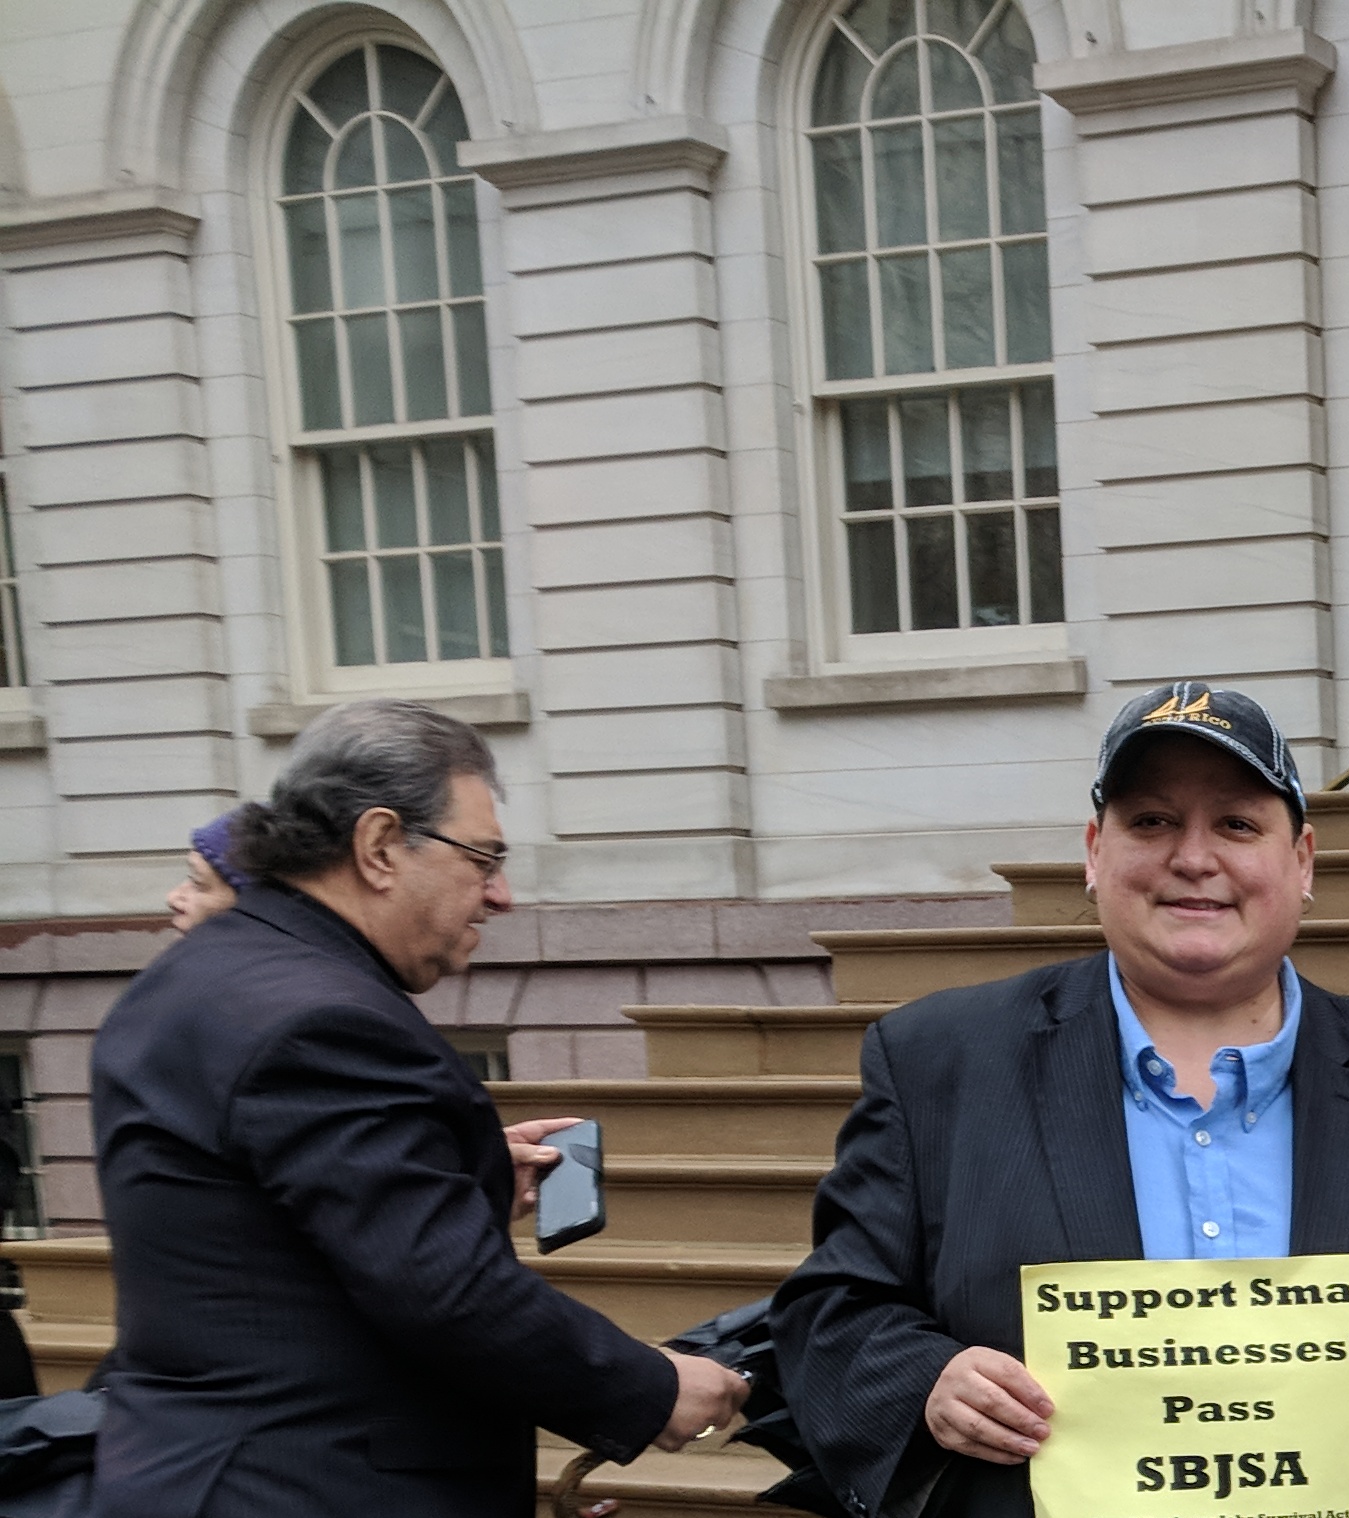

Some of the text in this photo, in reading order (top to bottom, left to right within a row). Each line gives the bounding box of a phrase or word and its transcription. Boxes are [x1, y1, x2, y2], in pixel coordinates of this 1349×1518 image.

[1037, 1281, 1237, 1319] Support
[1163, 1396, 1275, 1424] Pass
[1137, 1450, 1308, 1499] SBJSA
